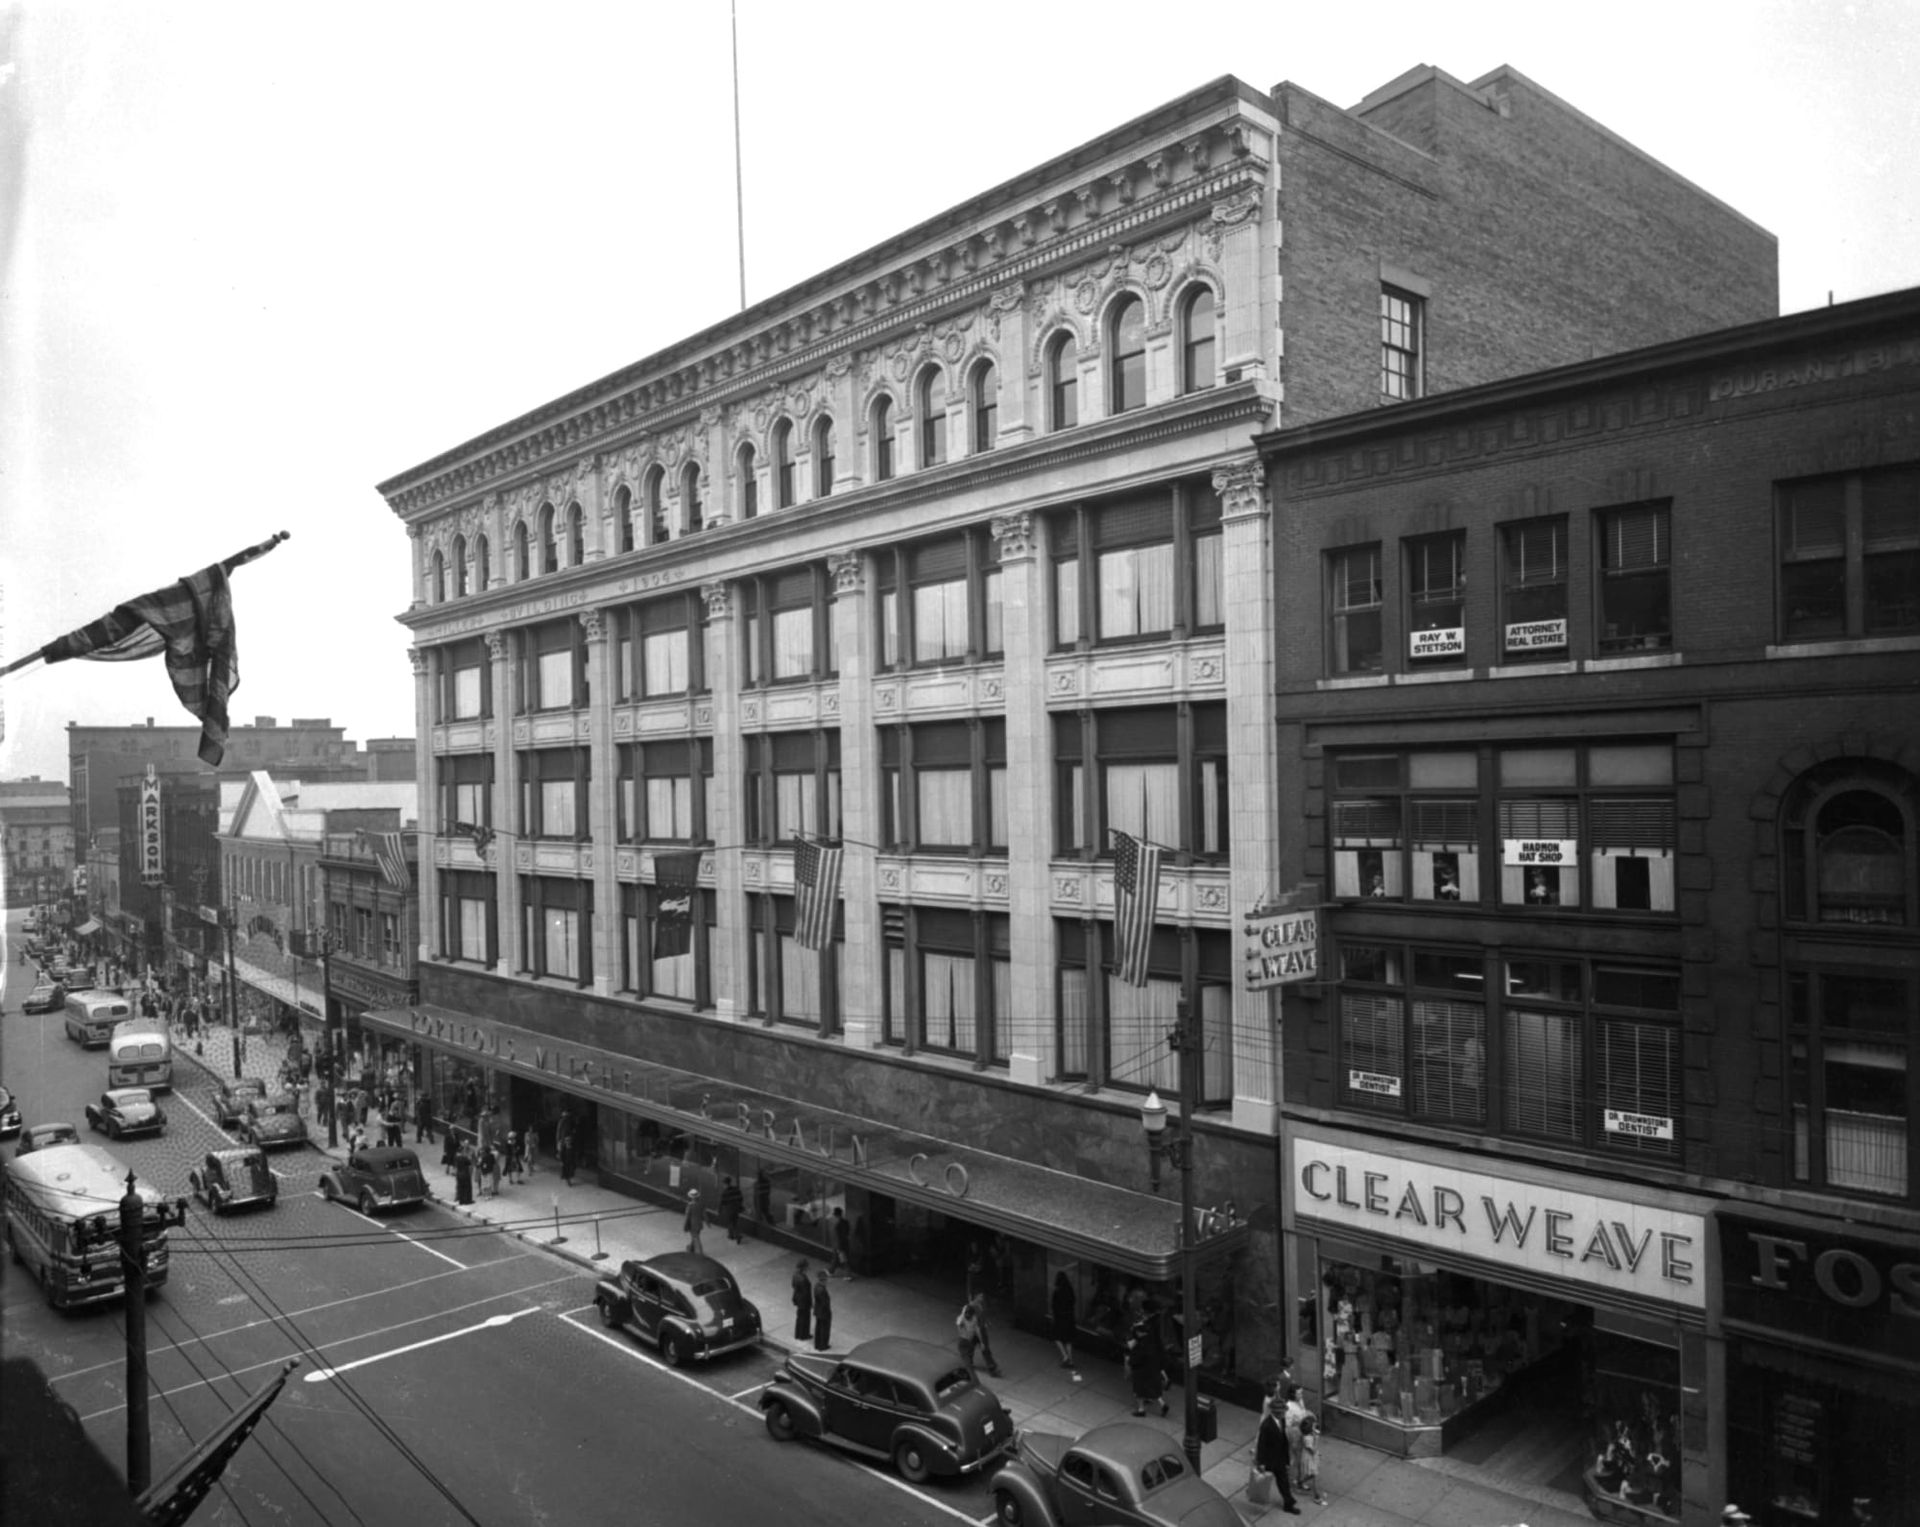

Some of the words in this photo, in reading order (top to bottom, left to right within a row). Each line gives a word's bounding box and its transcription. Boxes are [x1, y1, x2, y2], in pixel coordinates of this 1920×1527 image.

[1509, 622, 1562, 636] ATTORNEY
[1419, 632, 1441, 643] RAY
[1507, 637, 1528, 647] REAL
[1532, 634, 1564, 645] ESTATE
[1413, 642, 1462, 654] STETSON
[144, 778, 159, 871] MARKSON
[1522, 842, 1560, 852] HARMON
[1518, 852, 1536, 862] HAT
[1538, 852, 1563, 862] SHOP
[1261, 919, 1317, 949] CLEAR
[1261, 948, 1318, 979] WEAVE
[1359, 1080, 1390, 1093] DENTIST
[1618, 1121, 1659, 1136] DENTIST
[737, 1102, 869, 1170] BRAUN
[1301, 1160, 1467, 1234] CLEAR
[1481, 1196, 1693, 1285] WEAVE
